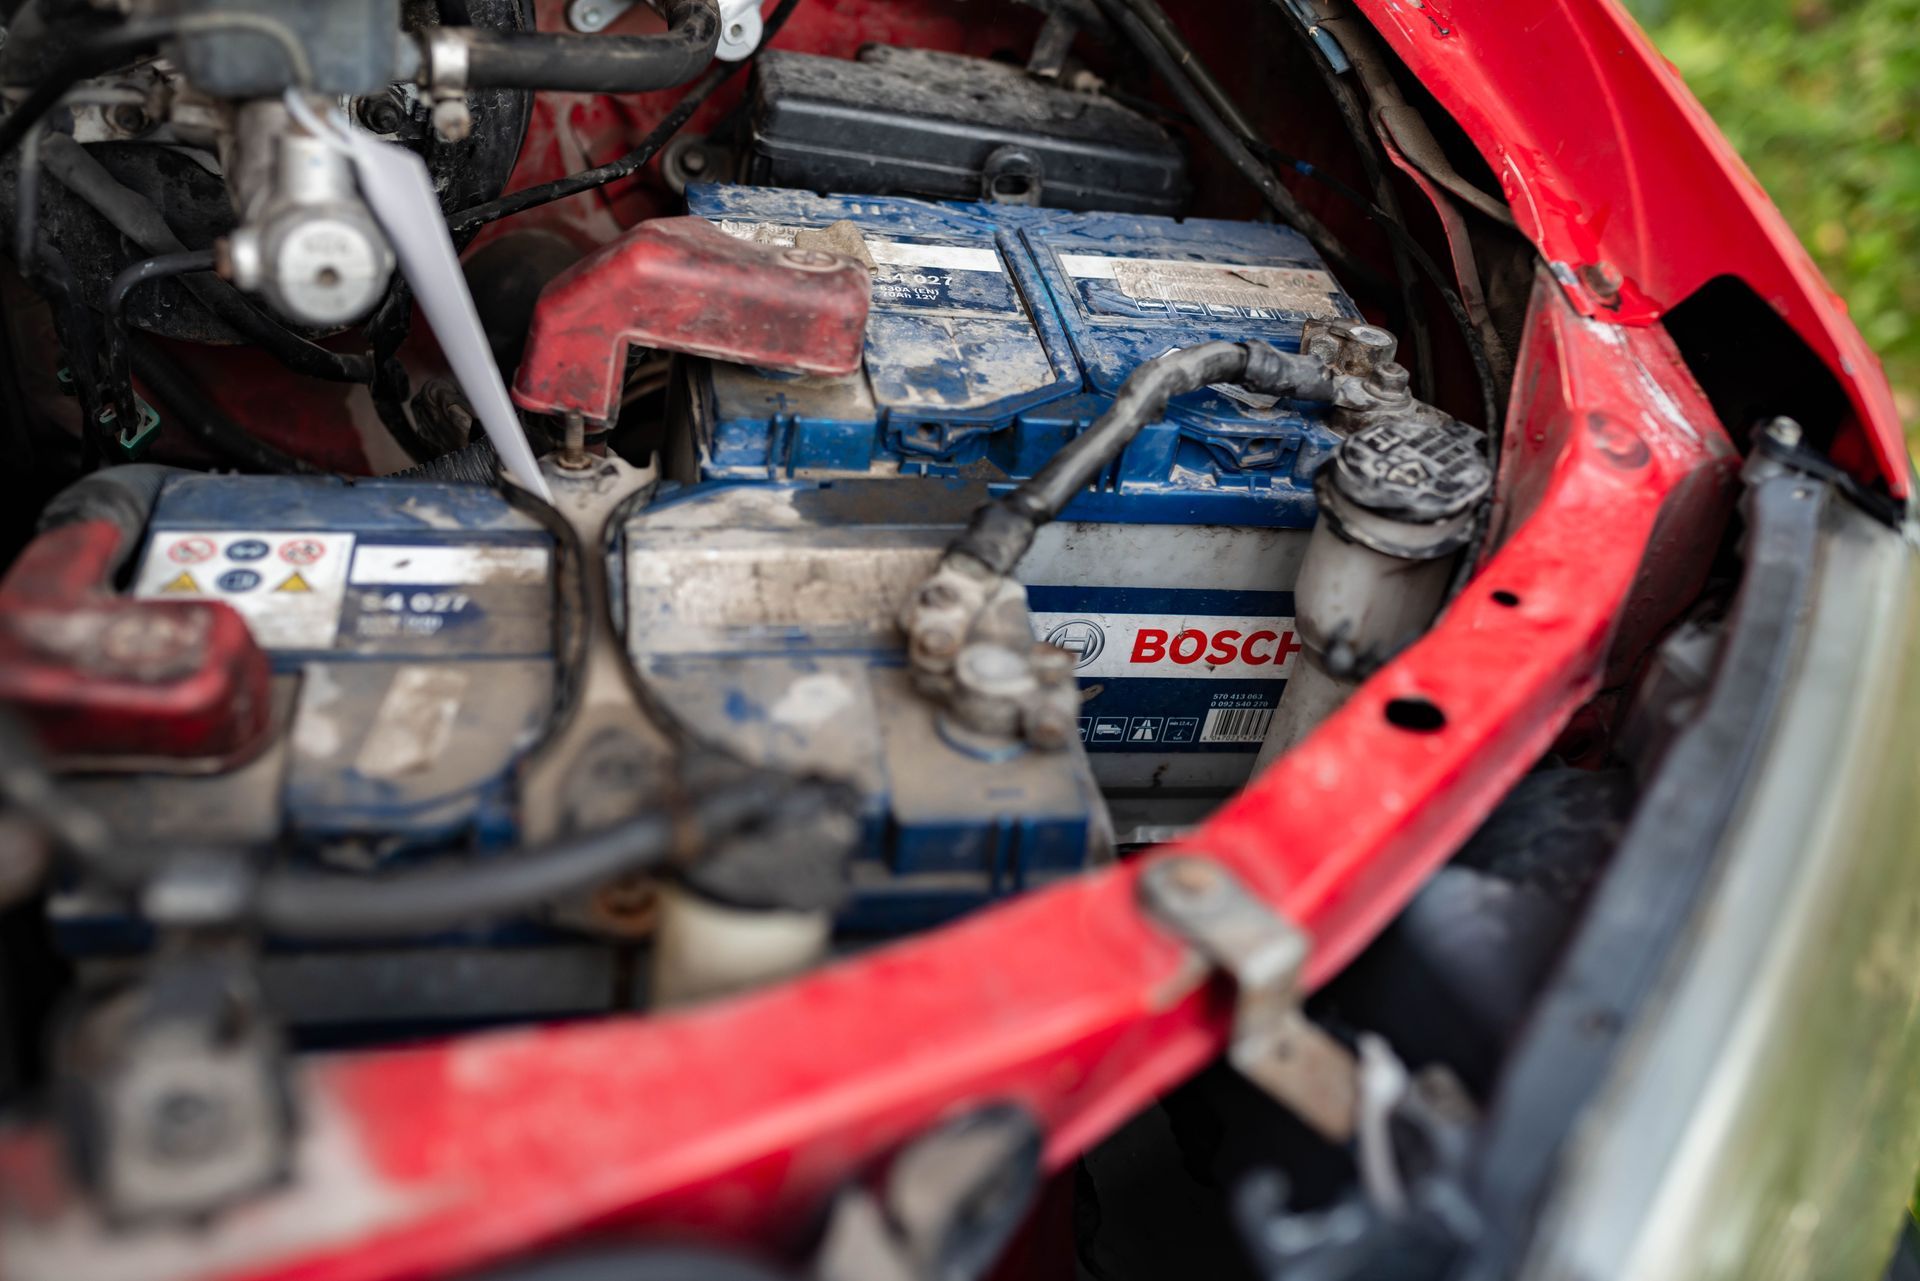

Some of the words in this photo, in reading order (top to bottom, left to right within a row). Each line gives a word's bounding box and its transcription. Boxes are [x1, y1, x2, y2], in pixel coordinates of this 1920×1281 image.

[913, 273, 953, 286] 027
[914, 286, 939, 296] (EN)
[410, 592, 470, 613] 027
[1130, 628, 1303, 665] BOSCH
